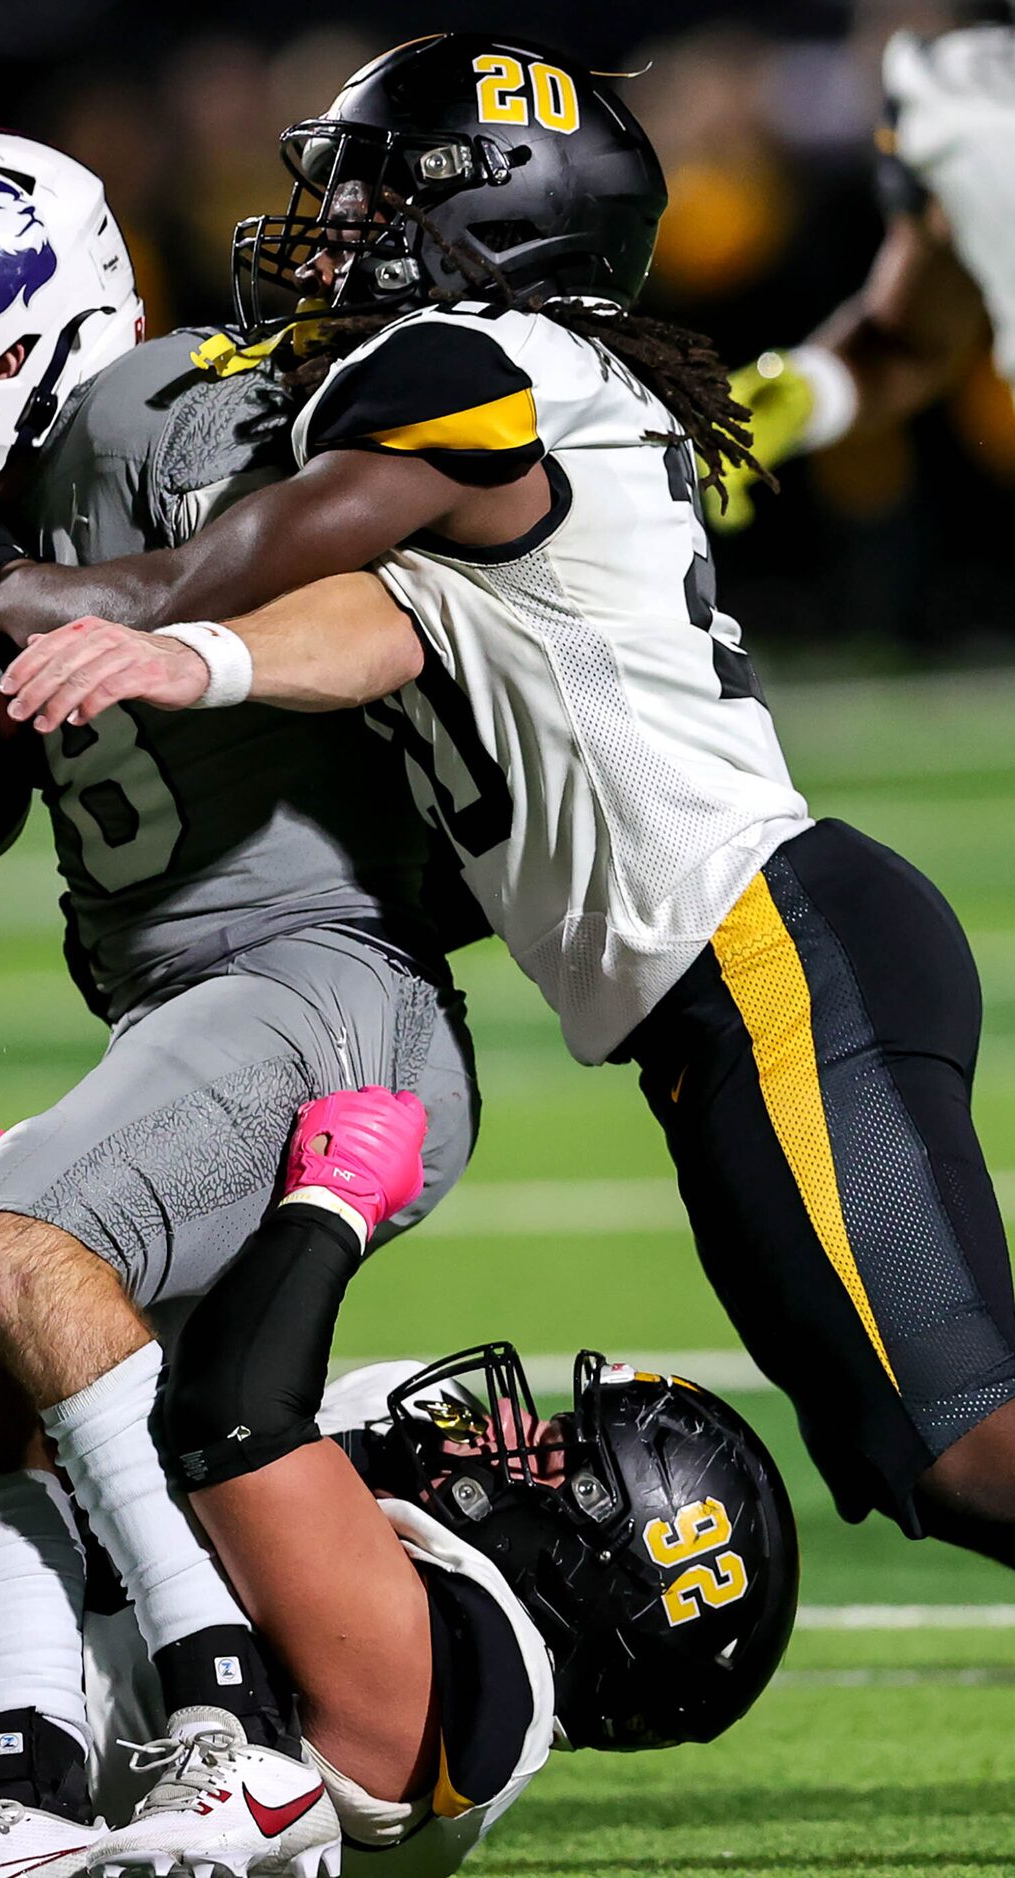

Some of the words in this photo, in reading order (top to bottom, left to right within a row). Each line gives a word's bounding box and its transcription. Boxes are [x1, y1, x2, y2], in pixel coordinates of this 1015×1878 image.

[472, 54, 580, 135] 20
[42, 700, 183, 888] 8
[642, 1496, 749, 1627] 92
